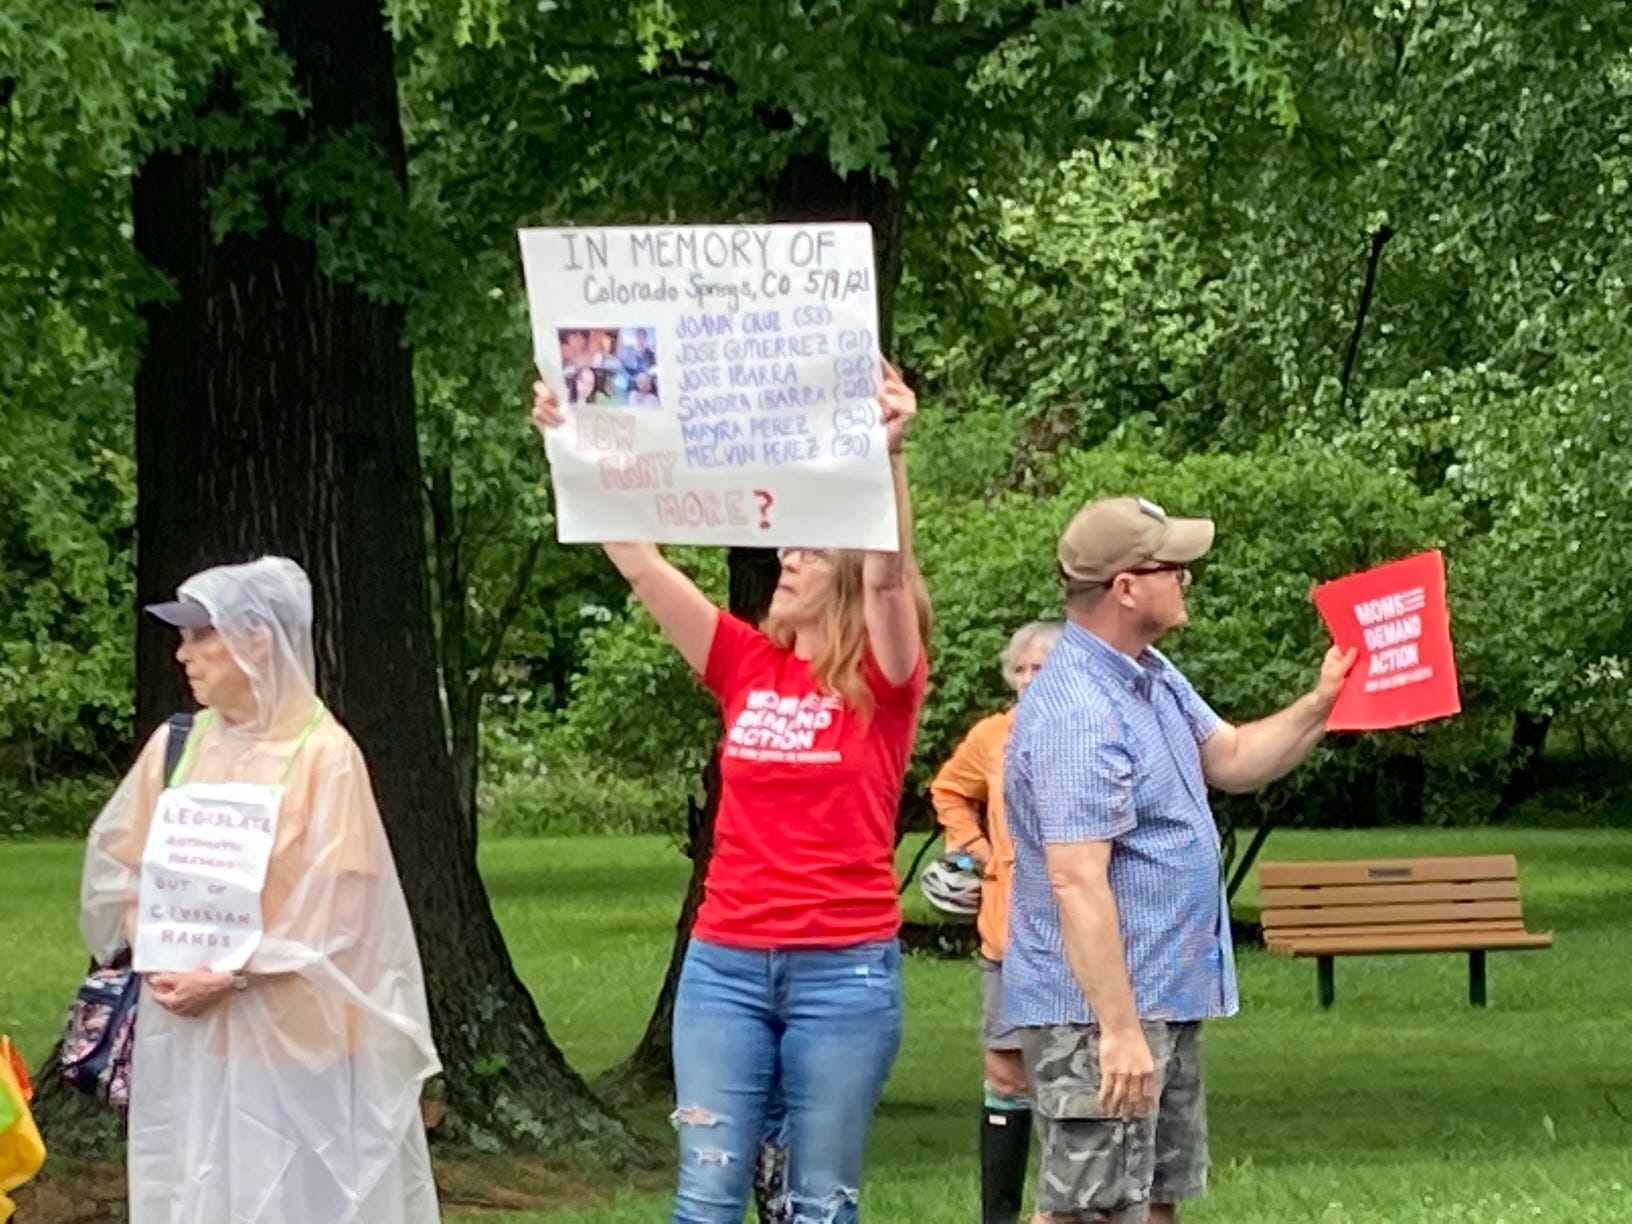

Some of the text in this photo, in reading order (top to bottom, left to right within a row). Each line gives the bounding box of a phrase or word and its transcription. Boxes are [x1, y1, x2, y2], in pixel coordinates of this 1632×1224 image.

[561, 230, 836, 270] IN MEMORY OF
[583, 273, 679, 304] Colorado
[678, 366, 721, 392] JOSE
[750, 414, 810, 439] PEREZ
[685, 444, 755, 468] MELVIN
[762, 437, 821, 465] PEREZ
[1363, 614, 1422, 652] DEMAND
[1367, 643, 1420, 677] ACTION
[162, 806, 272, 834] LEGISLATE
[154, 878, 191, 891] OUT
[149, 902, 251, 925] CIVILIAN
